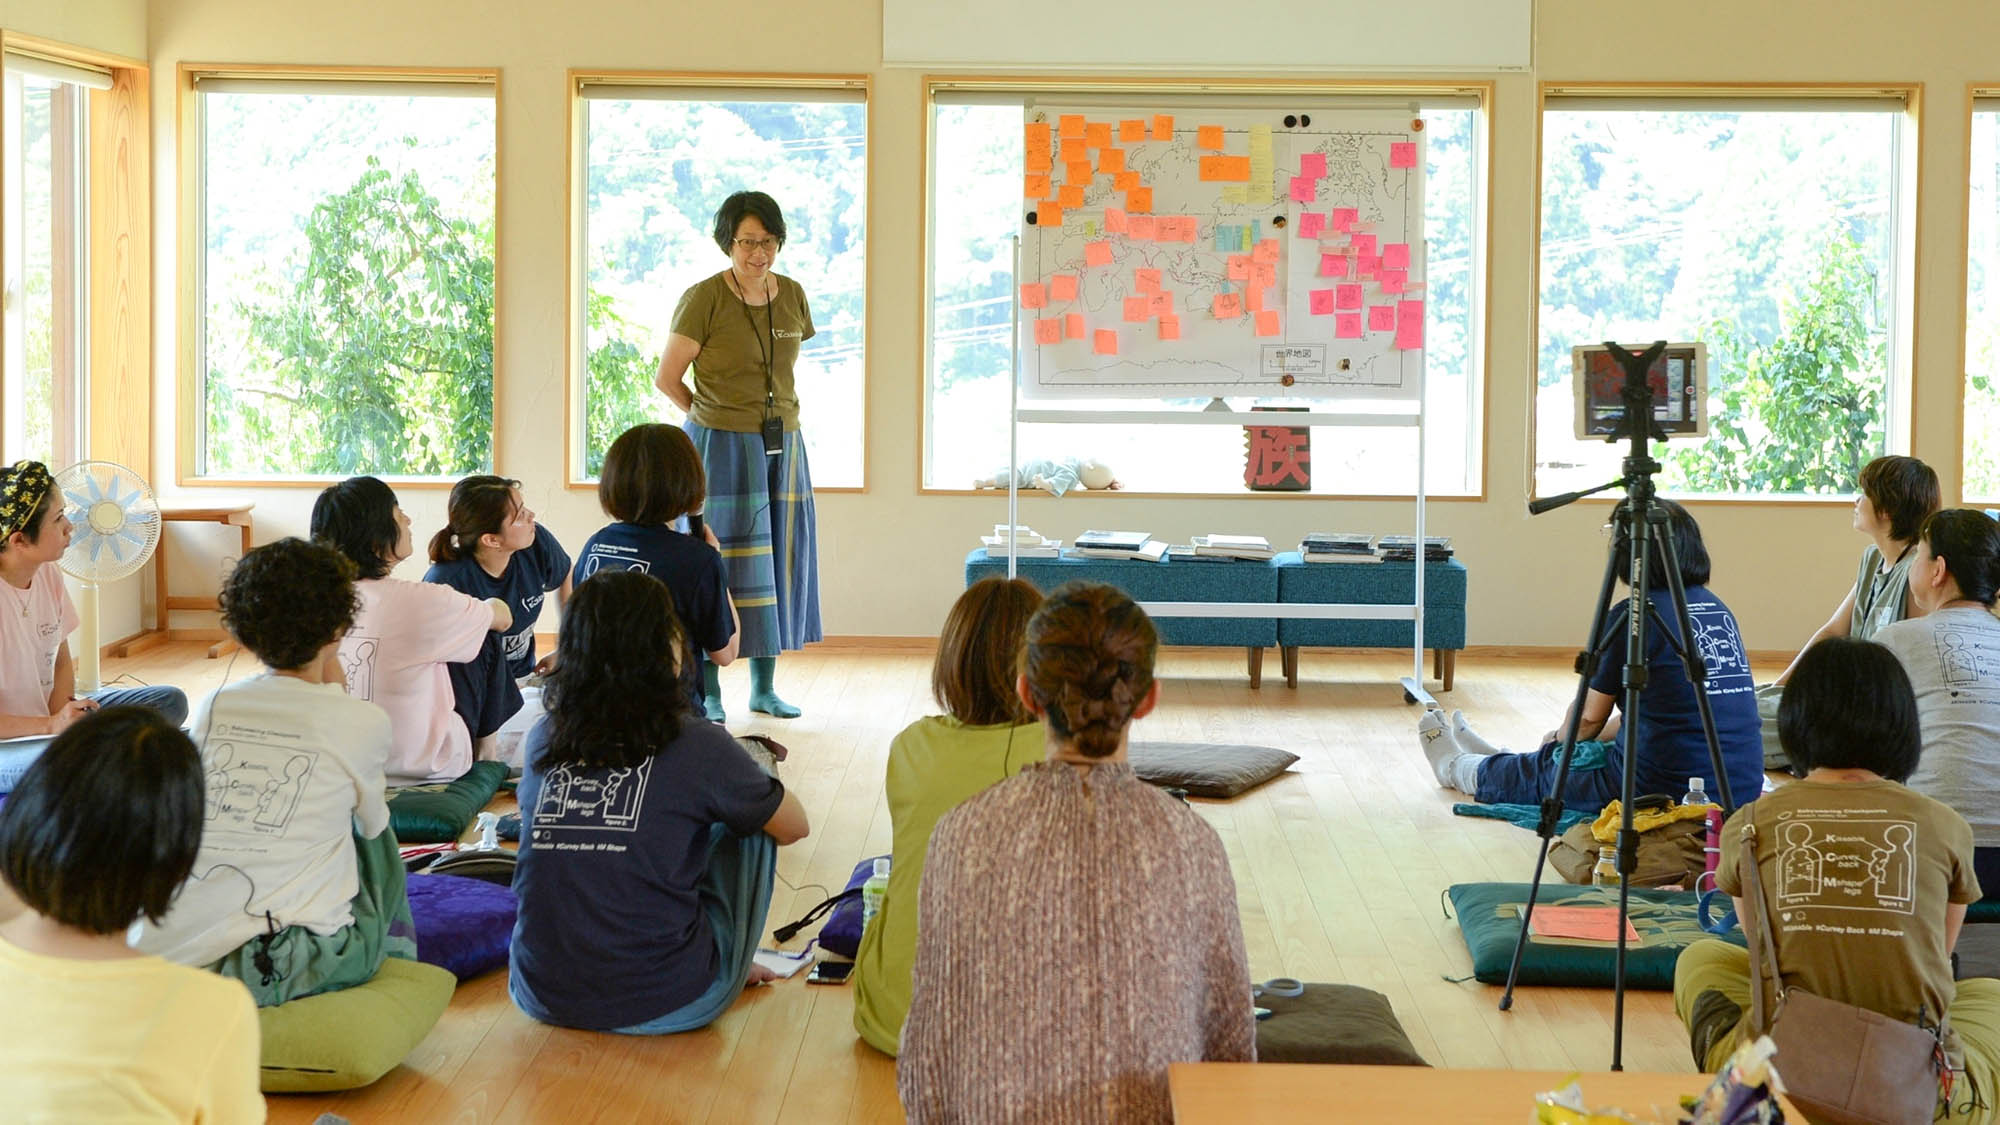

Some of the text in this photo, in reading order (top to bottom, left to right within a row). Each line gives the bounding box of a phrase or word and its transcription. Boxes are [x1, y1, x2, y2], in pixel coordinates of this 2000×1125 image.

[1276, 348, 1312, 358] 世界地図
[1243, 407, 1309, 486] 族
[1632, 613, 1640, 636] BLACK
